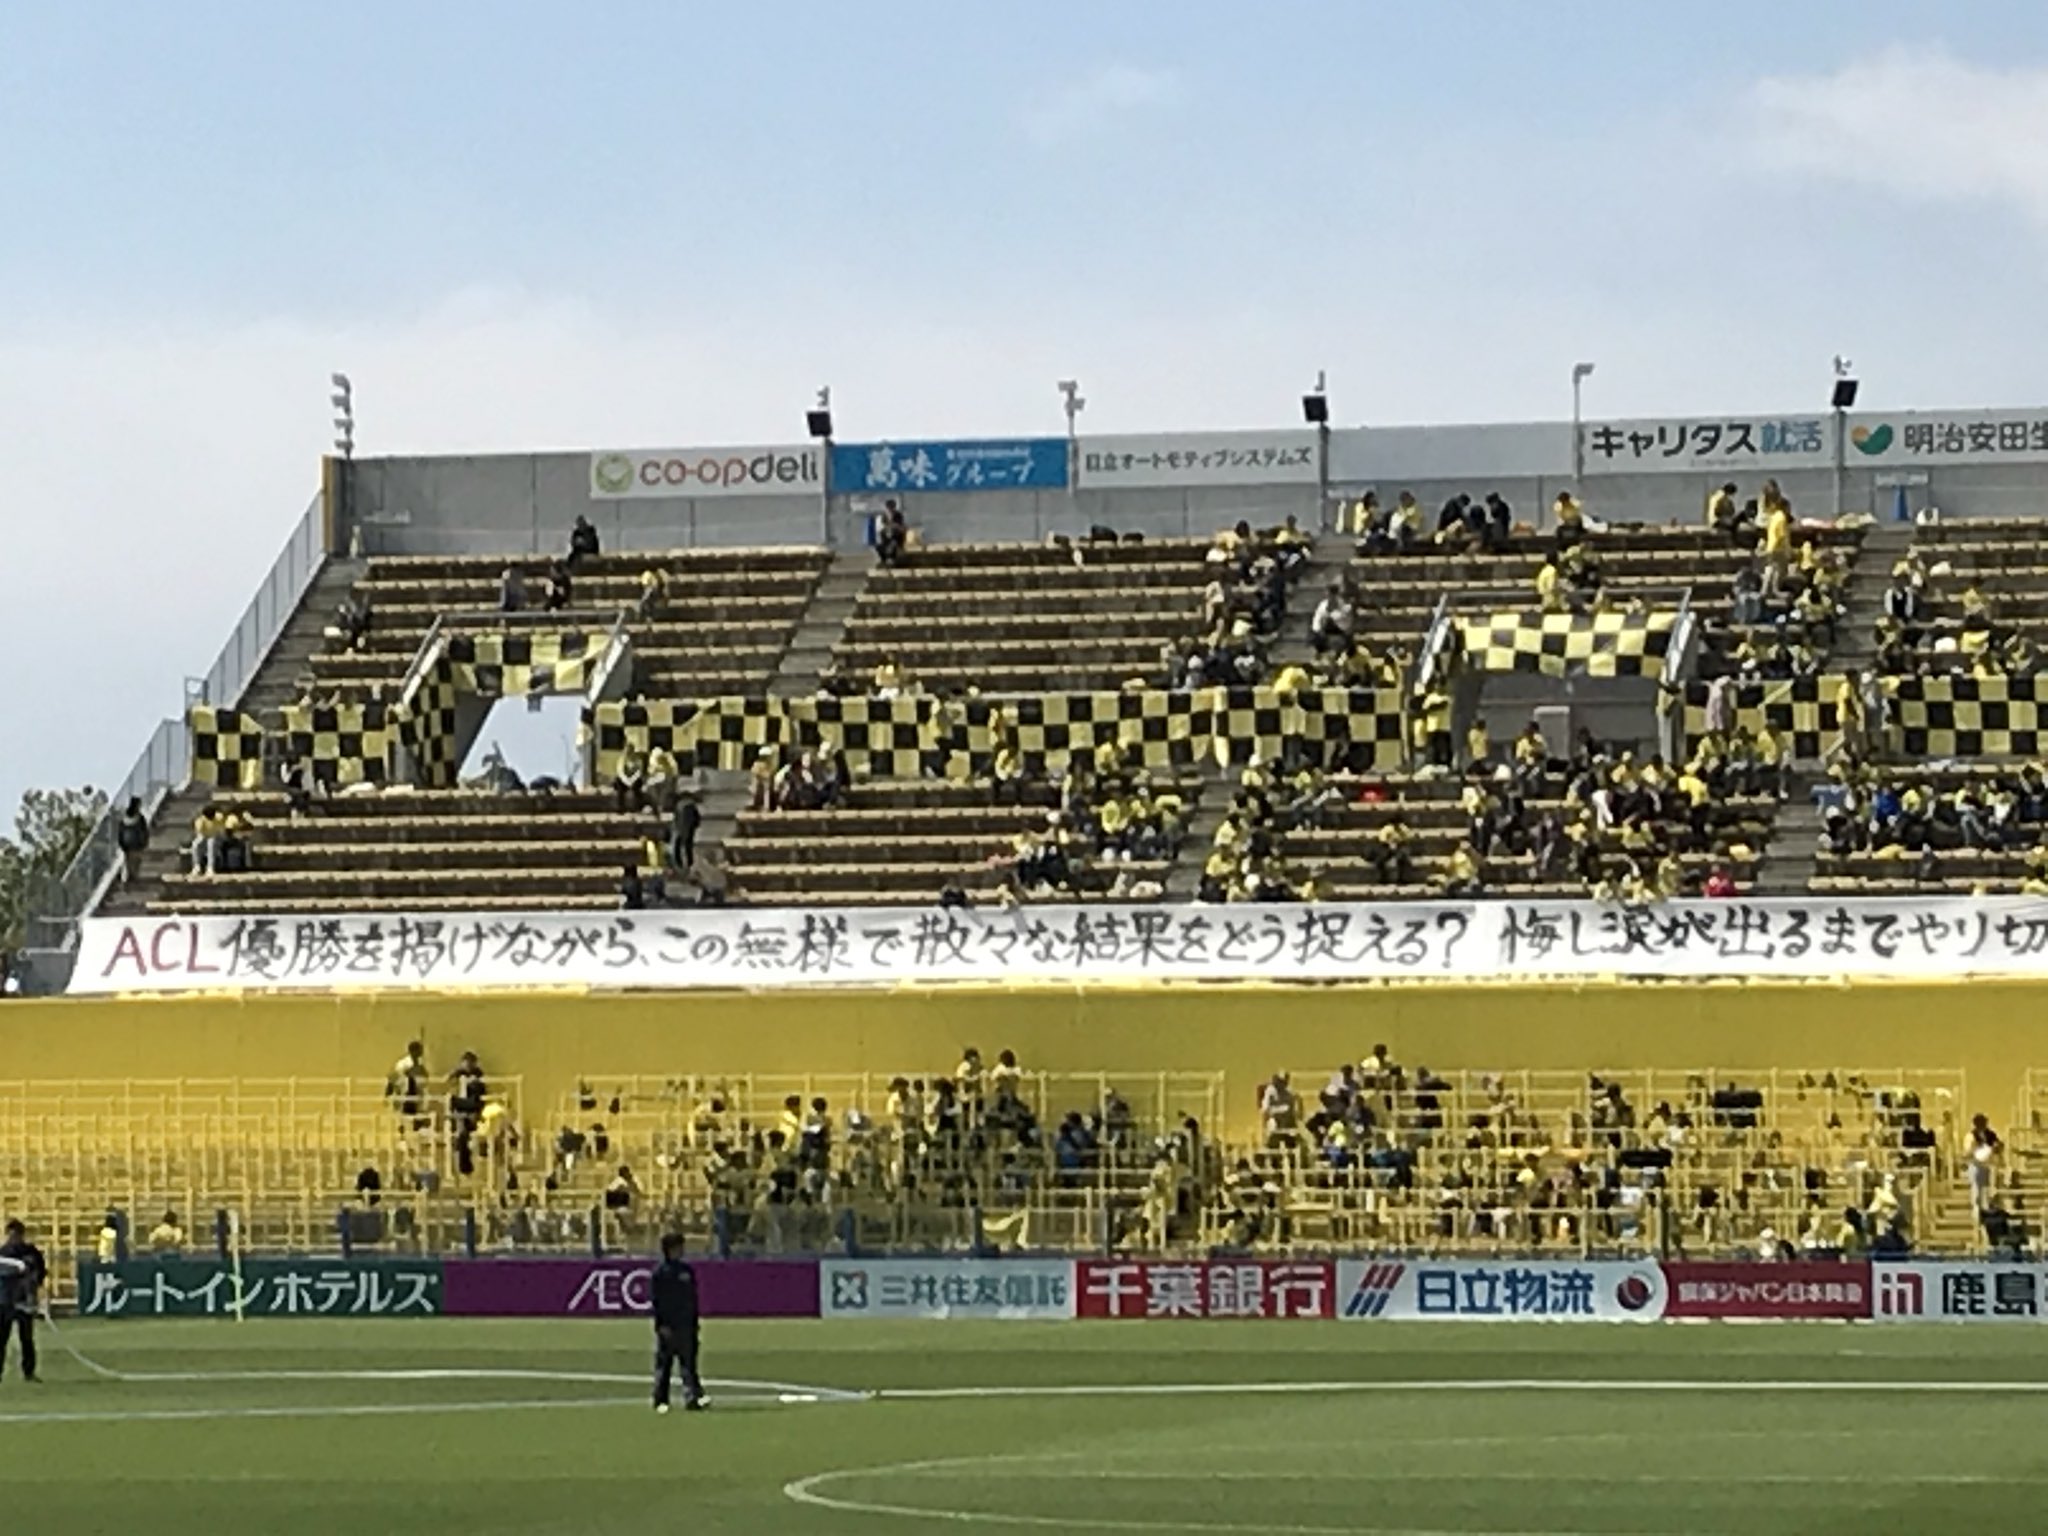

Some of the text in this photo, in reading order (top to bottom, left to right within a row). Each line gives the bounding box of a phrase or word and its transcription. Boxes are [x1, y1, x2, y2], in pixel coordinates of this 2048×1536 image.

[1086, 446, 1312, 473] 日立オートモティブシステムズ
[1592, 420, 1823, 457] キャリタス就活
[1086, 1265, 1327, 1317] 千葉銀行
[1416, 1270, 1594, 1315] 日立物流
[1942, 1271, 2048, 1315] 鹿島
